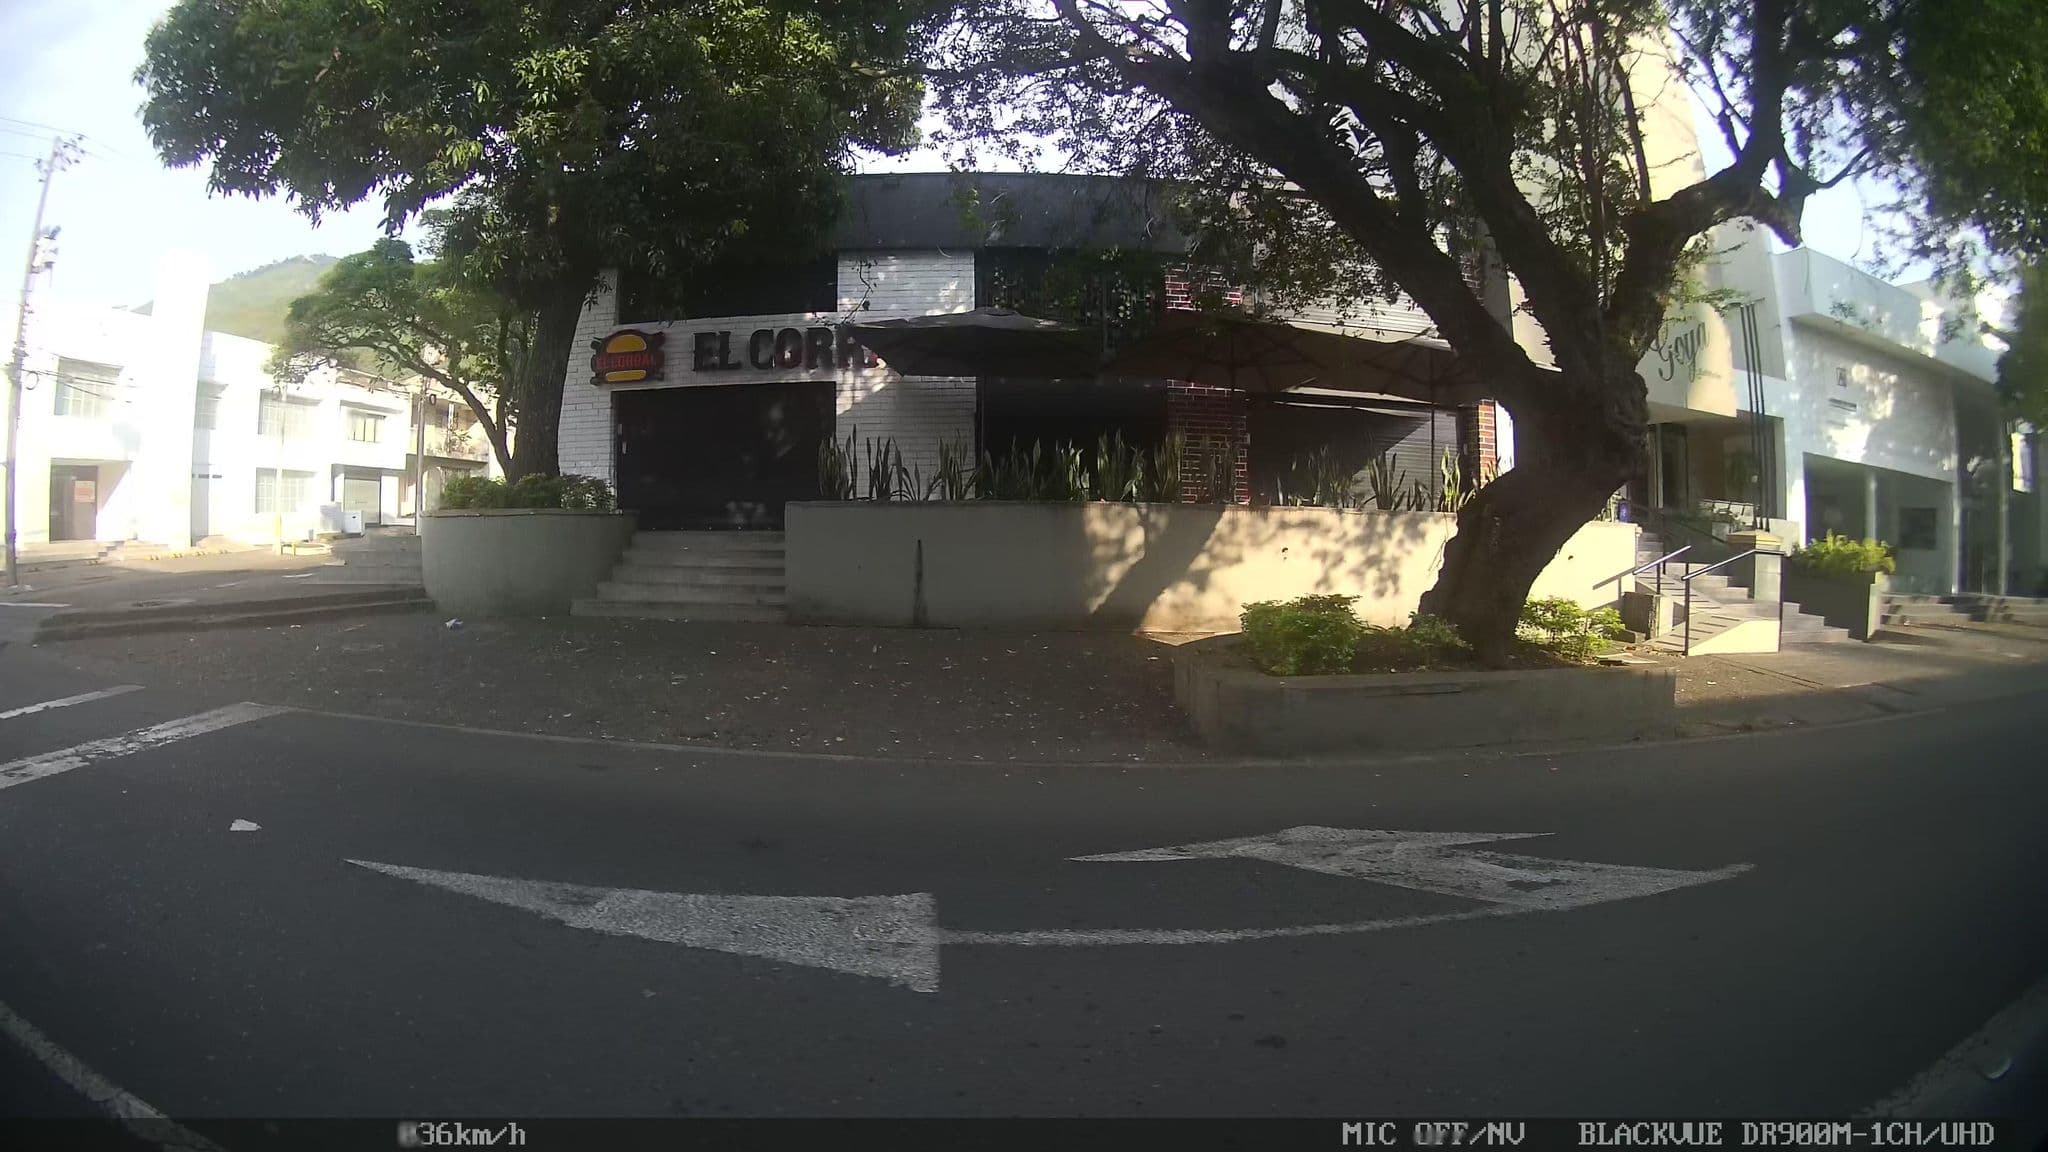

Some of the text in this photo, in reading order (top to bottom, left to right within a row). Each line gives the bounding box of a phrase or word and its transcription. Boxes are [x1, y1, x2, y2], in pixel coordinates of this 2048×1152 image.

[692, 326, 879, 372] EL CORR
[1650, 321, 1709, 383] Goya
